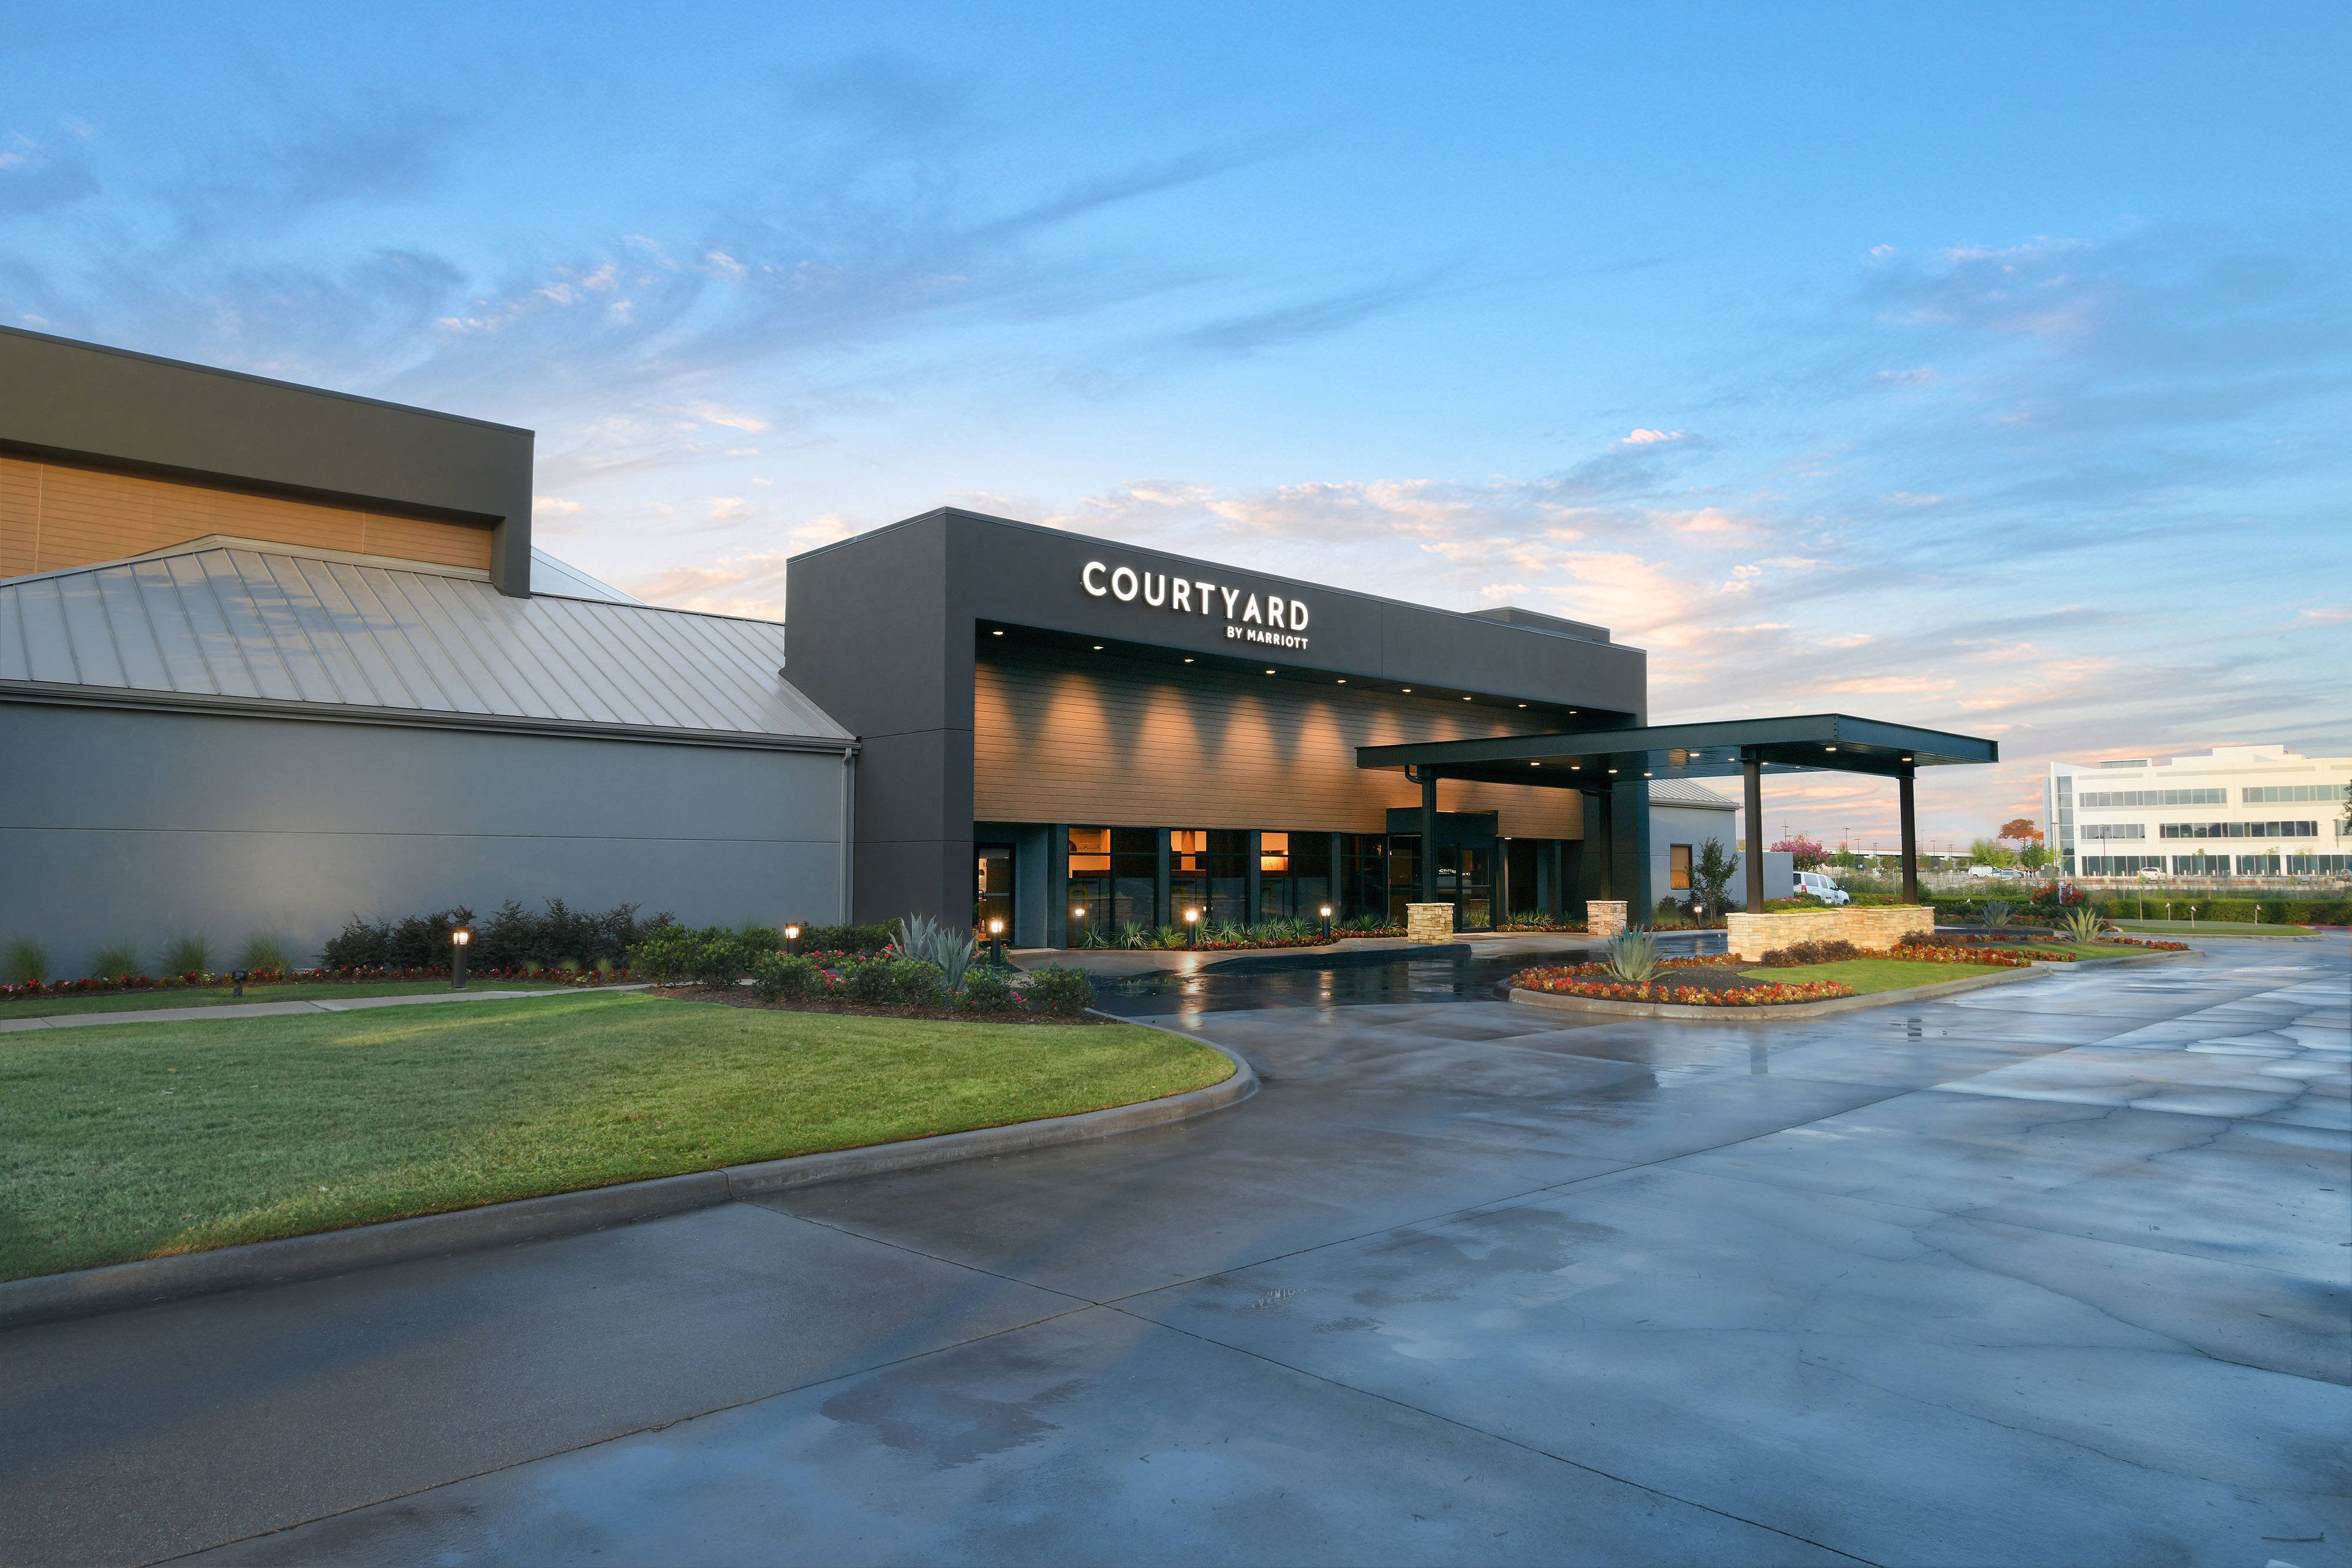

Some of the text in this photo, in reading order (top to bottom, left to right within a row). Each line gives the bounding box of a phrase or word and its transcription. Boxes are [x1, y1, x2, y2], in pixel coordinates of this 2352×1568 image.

[1081, 560, 1309, 631] COURTYARD
[1226, 625, 1309, 650] BY MARRIOTT
